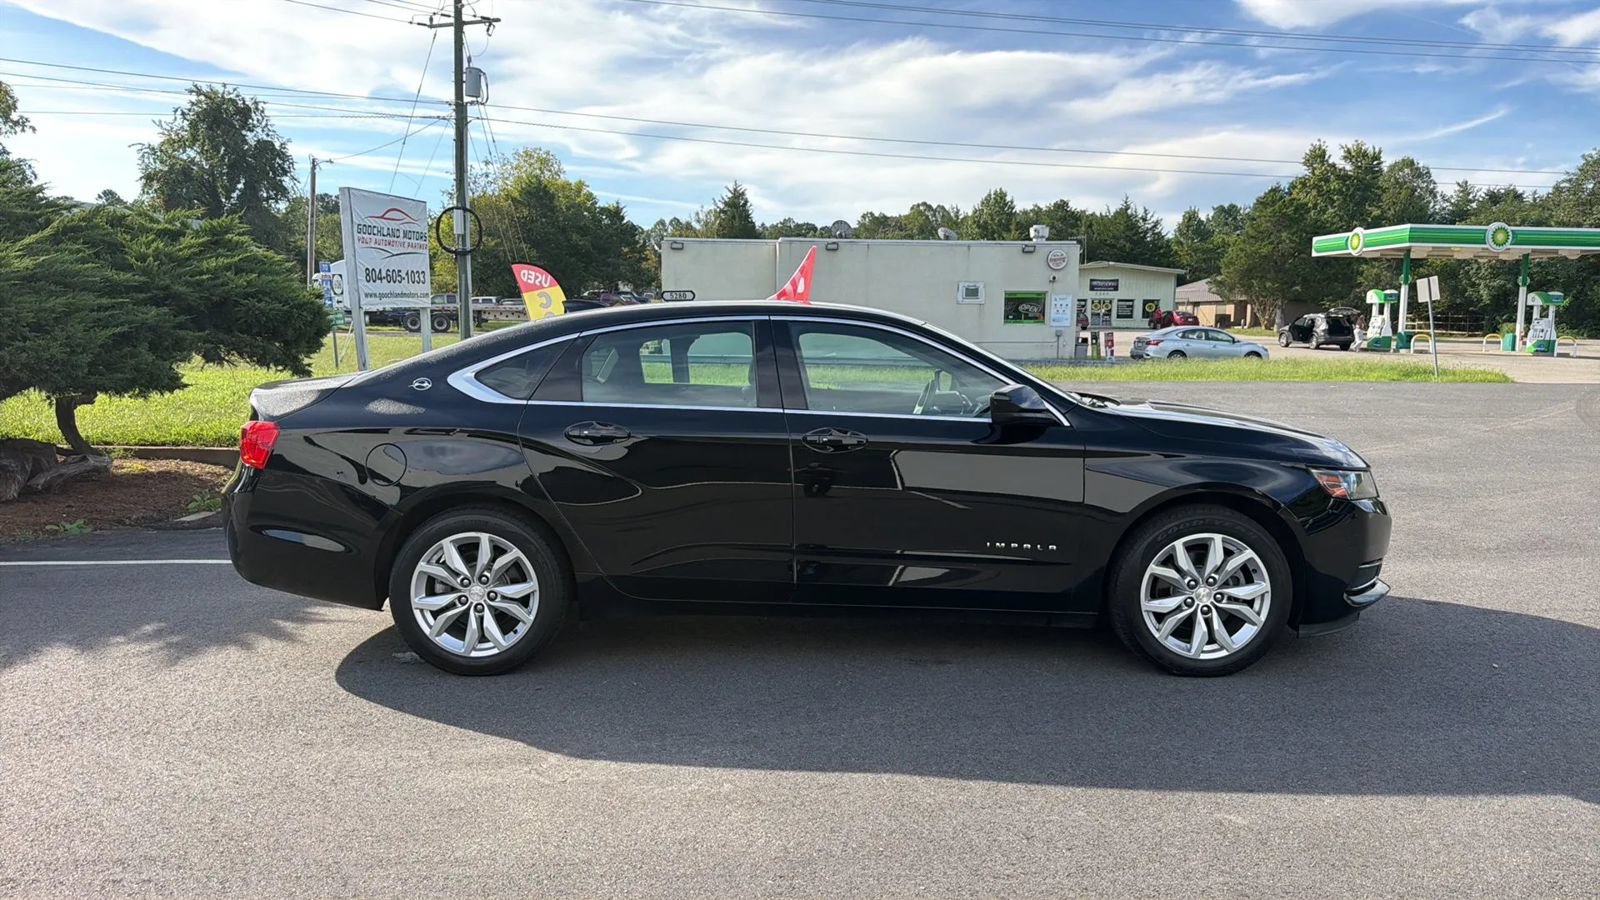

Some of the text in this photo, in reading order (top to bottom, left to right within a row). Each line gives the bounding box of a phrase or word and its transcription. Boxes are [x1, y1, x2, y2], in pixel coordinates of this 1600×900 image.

[357, 223, 428, 242] GOOCHLAND MOTORS
[374, 238, 405, 248] AUTOMOTIVE
[365, 267, 426, 284] 804-605-1033
[364, 291, 430, 300] www.goochlandmotors.com
[986, 541, 1057, 551] IMPALA
